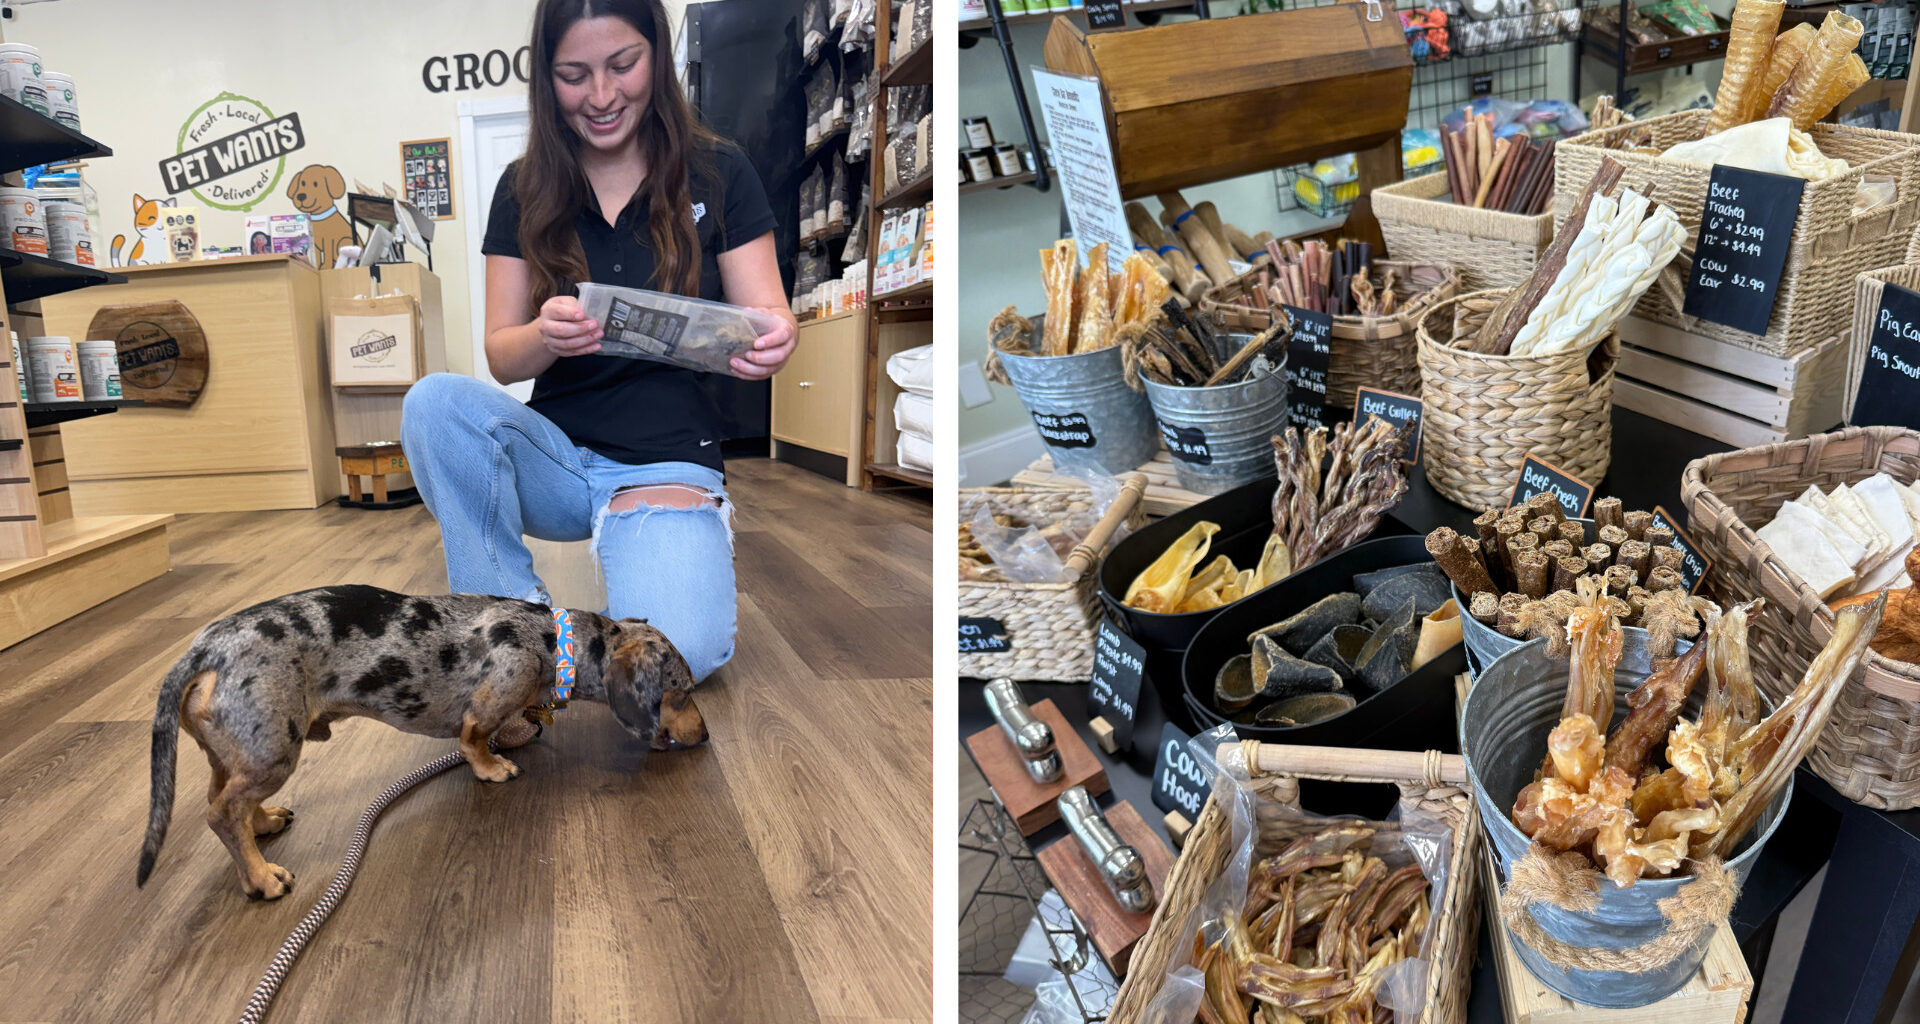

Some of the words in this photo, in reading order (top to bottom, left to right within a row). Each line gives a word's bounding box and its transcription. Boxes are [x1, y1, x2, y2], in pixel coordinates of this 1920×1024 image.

[190, 111, 218, 143] Fresh
[226, 104, 261, 124] Local
[165, 149, 210, 191] PET
[212, 118, 298, 173] WANTS
[212, 172, 270, 200] Delivered
[1711, 182, 1739, 200] Beef
[1709, 217, 1725, 230] 6"
[1703, 234, 1719, 246] 12"
[1699, 273, 1723, 289] Ear
[1731, 273, 1766, 293] $2.99
[1879, 308, 1900, 338] Pig
[1871, 345, 1889, 369] Pig
[1363, 396, 1387, 415] Beef
[1523, 465, 1550, 491] Beef
[1685, 554, 1703, 576] Chip
[1165, 739, 1207, 787] Cow
[1162, 767, 1200, 814] Hoof
